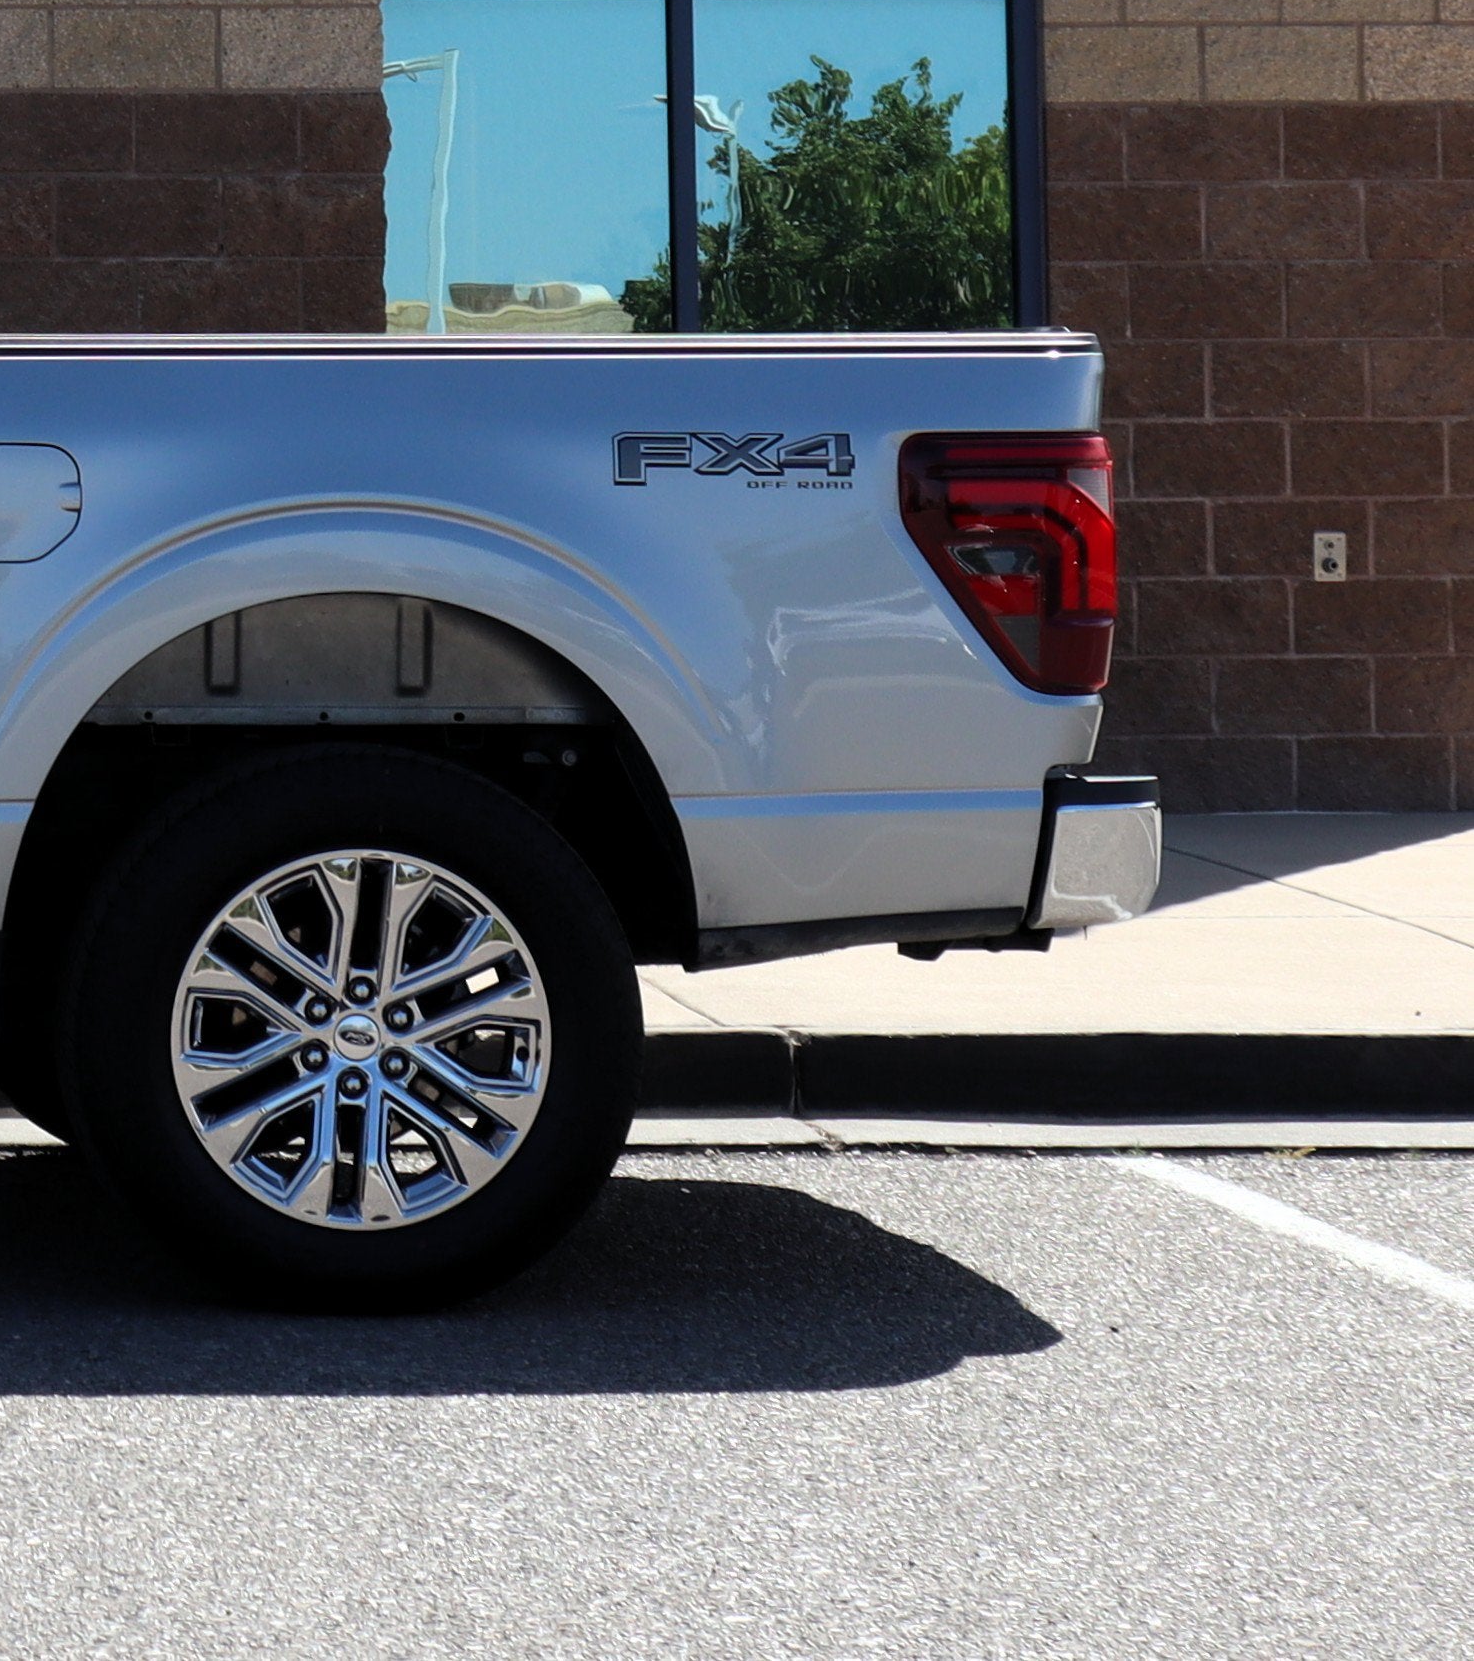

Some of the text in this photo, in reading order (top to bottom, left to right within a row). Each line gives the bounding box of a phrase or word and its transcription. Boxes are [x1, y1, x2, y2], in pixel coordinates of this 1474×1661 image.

[612, 432, 855, 486] FX4
[747, 481, 853, 489] OFF ROAD
